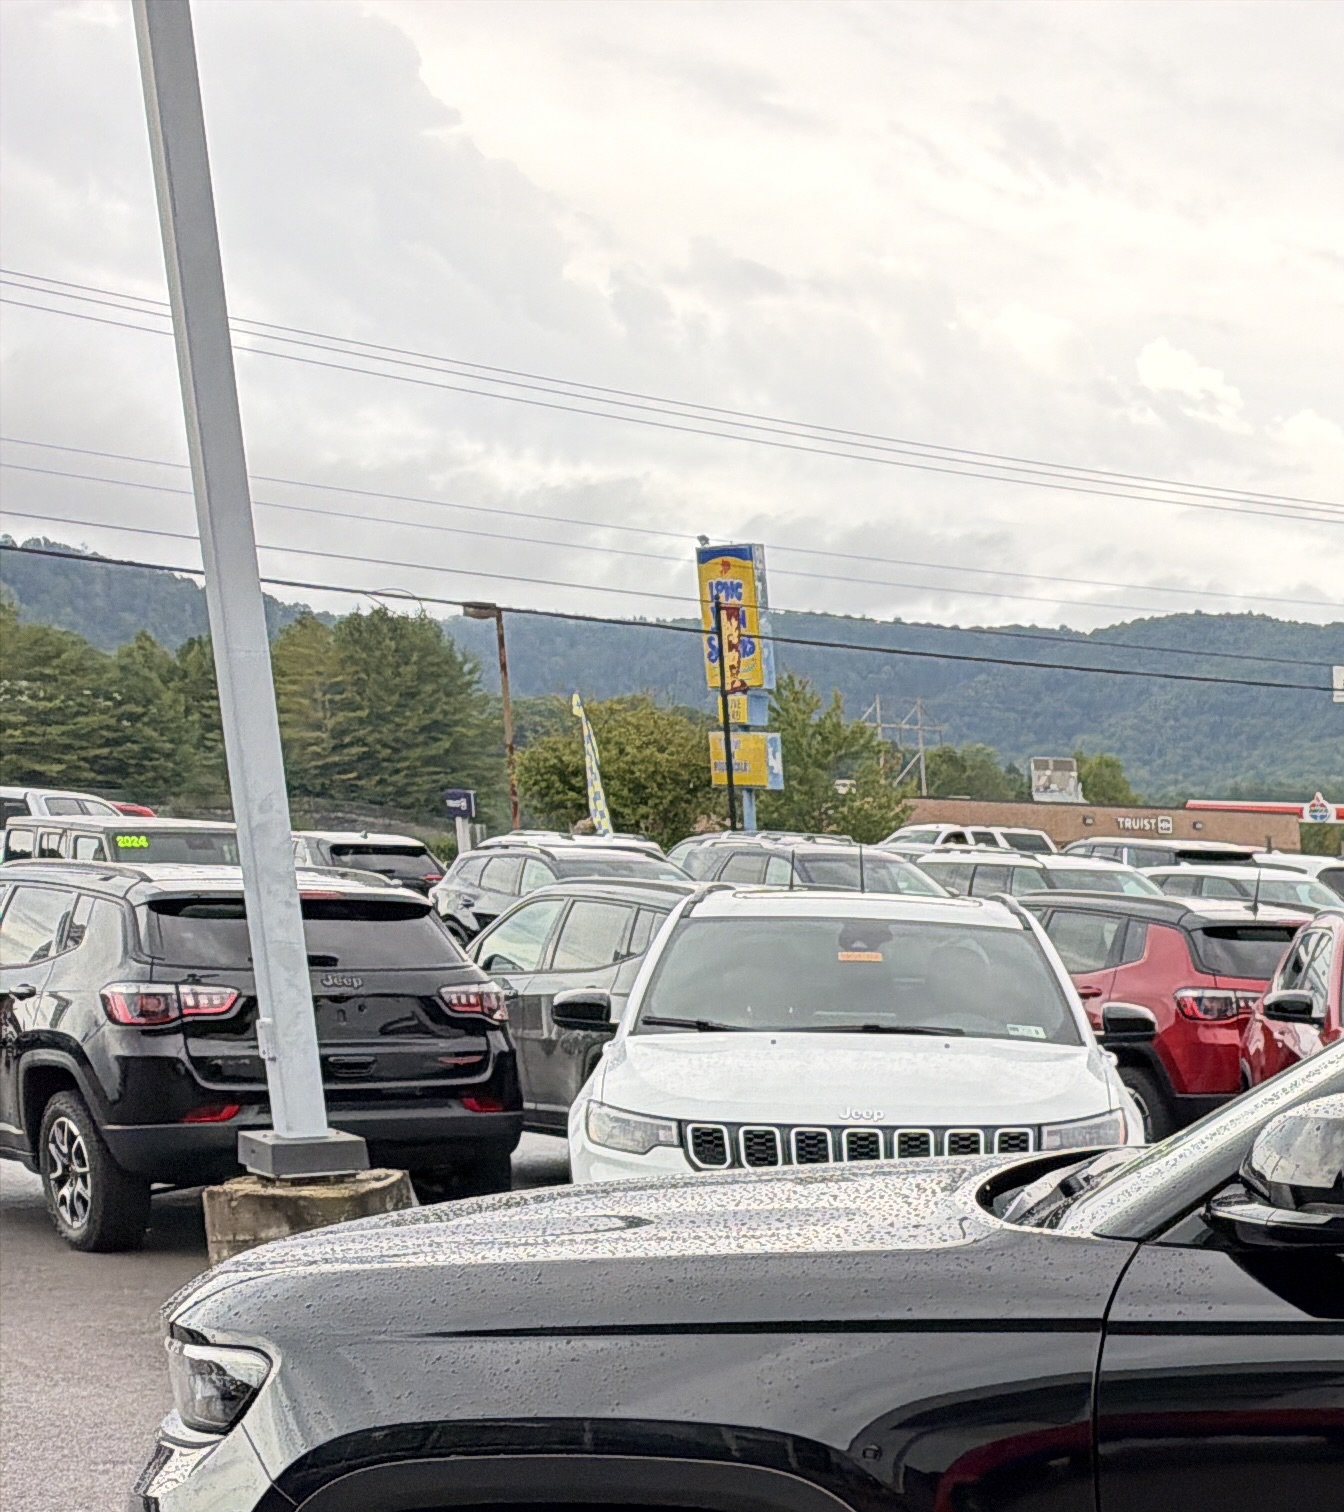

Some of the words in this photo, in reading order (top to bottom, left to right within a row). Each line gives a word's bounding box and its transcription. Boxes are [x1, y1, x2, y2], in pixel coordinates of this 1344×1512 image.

[1117, 816, 1157, 831] TRUIST
[321, 974, 363, 990] Jeep
[838, 1106, 885, 1122] Jeep
